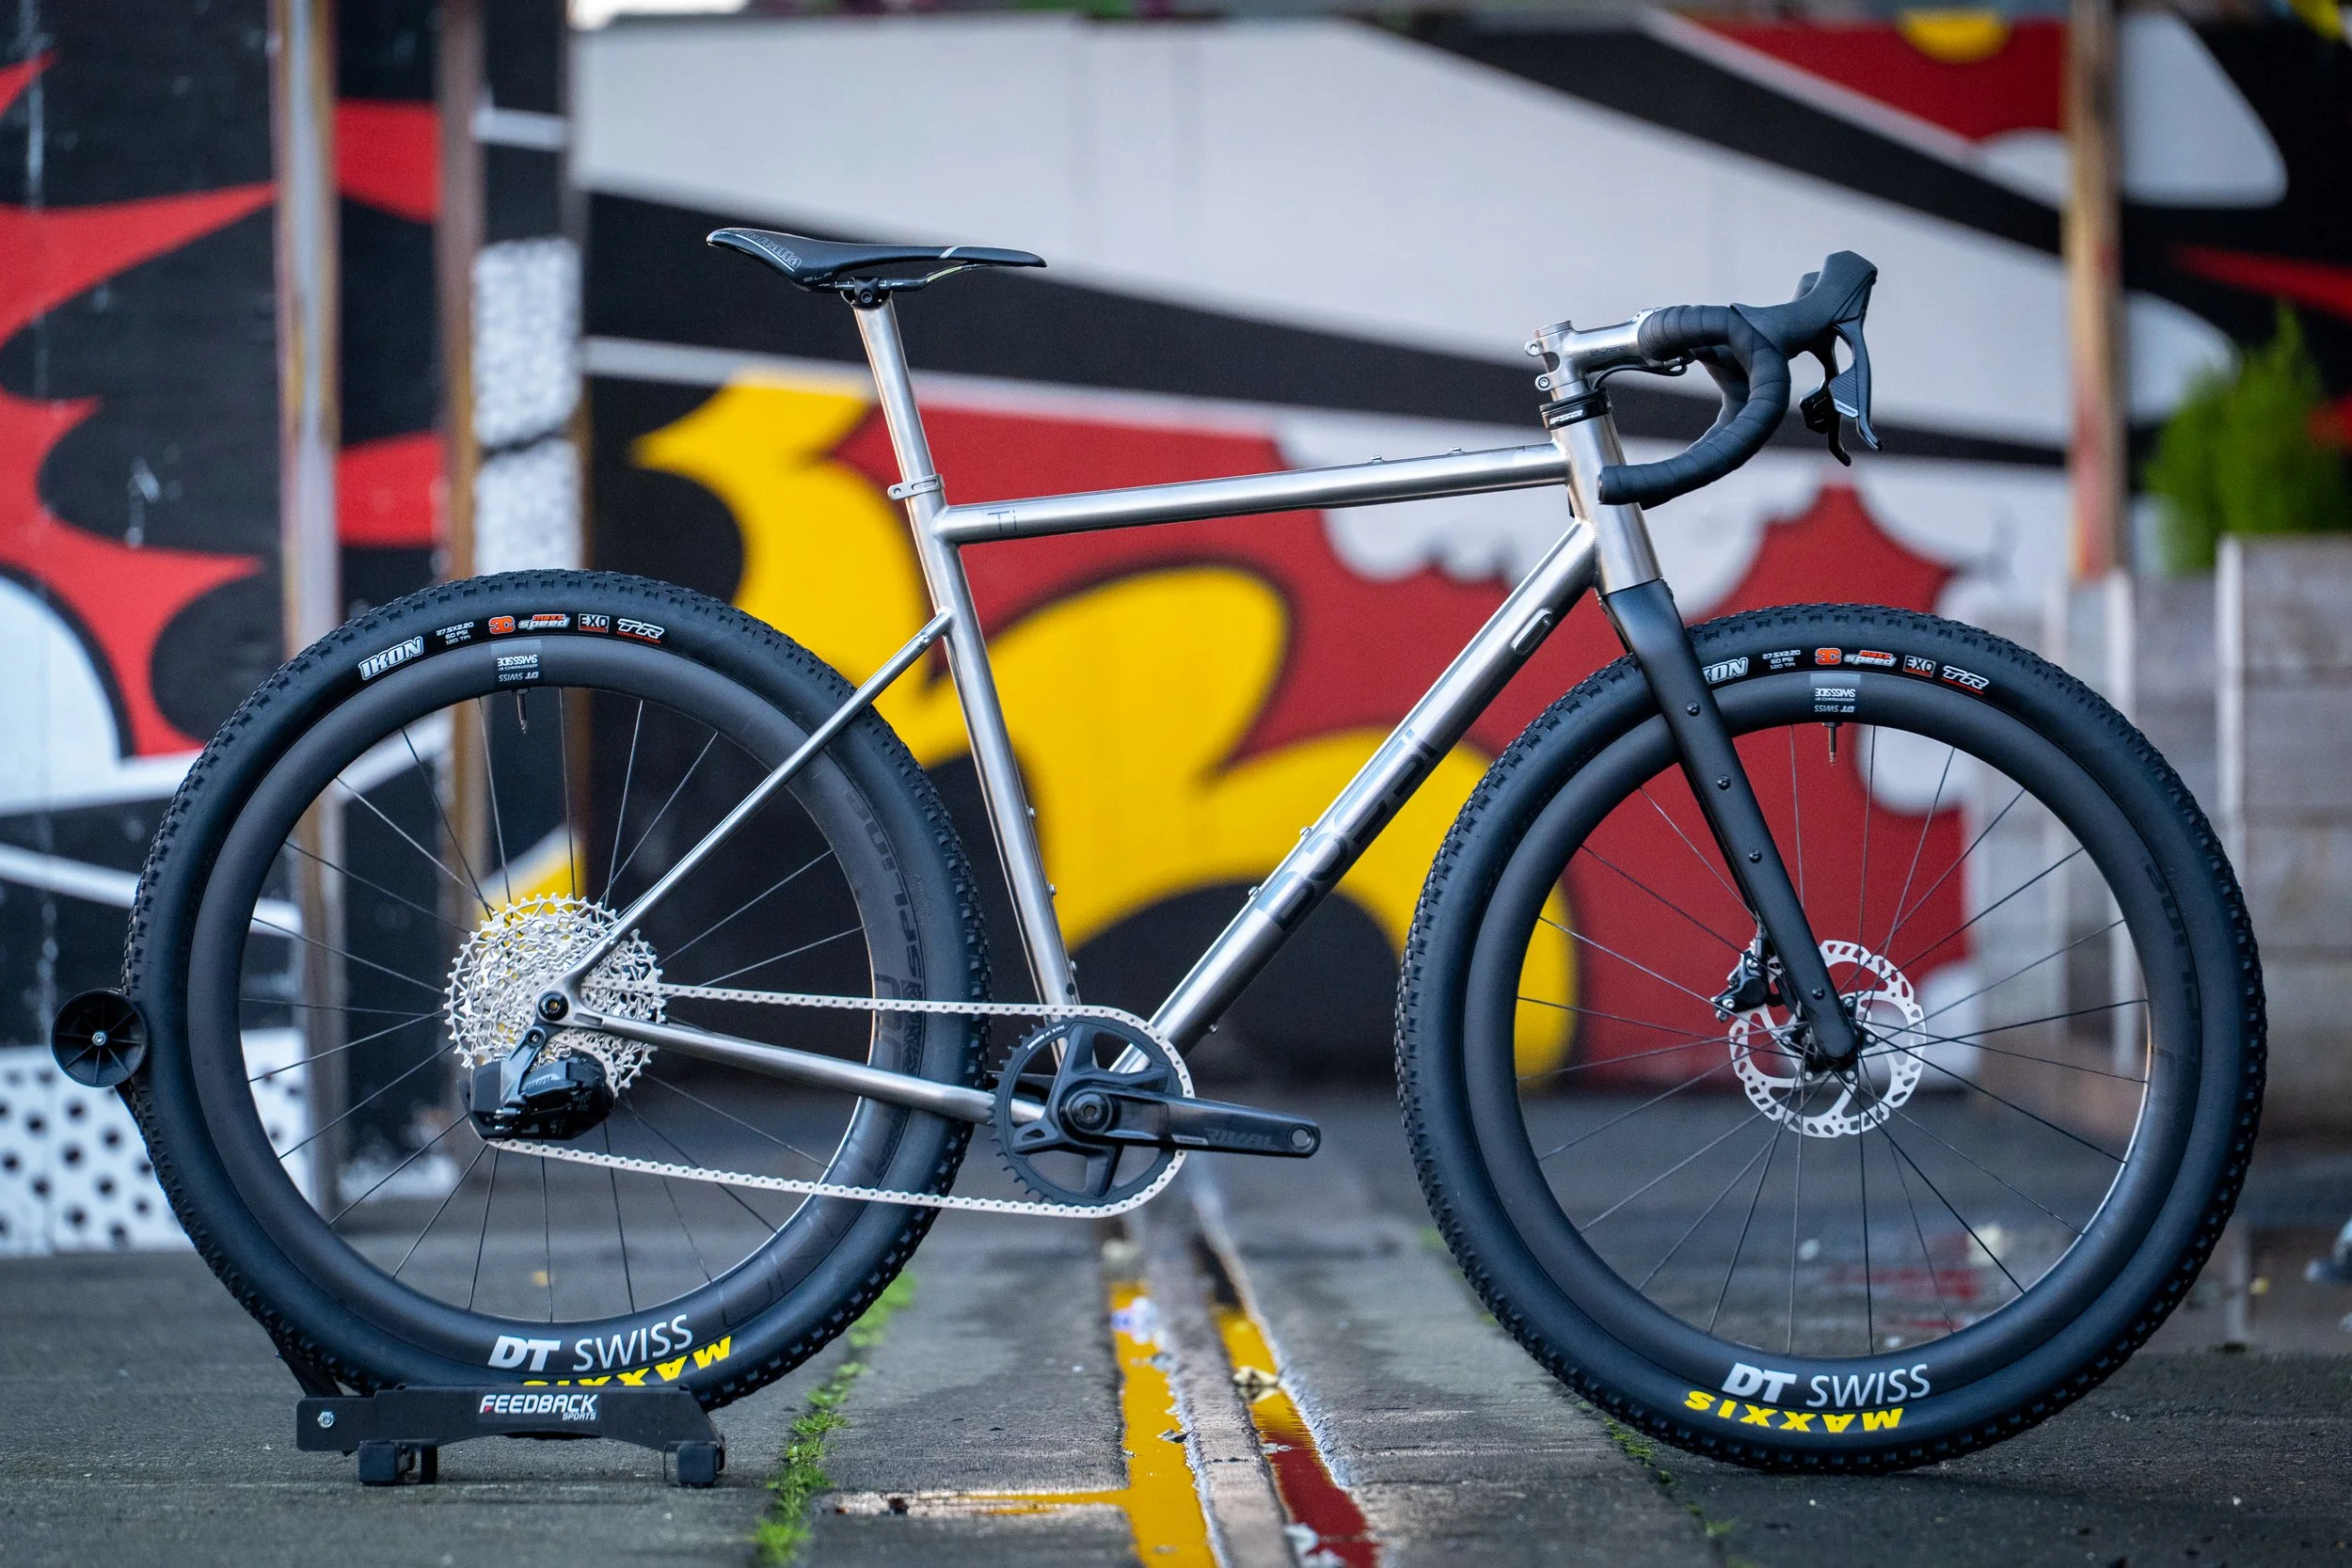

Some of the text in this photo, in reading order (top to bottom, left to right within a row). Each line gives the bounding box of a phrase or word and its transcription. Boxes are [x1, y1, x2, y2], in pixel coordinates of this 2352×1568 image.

[987, 509, 1018, 533] Ti
[518, 617, 570, 630] speed
[579, 614, 610, 628] EXO
[617, 618, 664, 640] TR
[358, 636, 423, 680] IKON
[1843, 653, 1897, 668] speed
[1905, 657, 1935, 673] EXO
[498, 671, 539, 682] DT SWISS
[1942, 665, 1990, 689] TR
[1839, 705, 1855, 713] DT
[1256, 728, 1437, 932] BOSSI
[487, 1313, 693, 1371] DT SWISS
[1721, 1362, 1931, 1408] DT SWISS
[479, 1394, 598, 1414] FEEDBACK
[1683, 1390, 1904, 1433] MAXXIS
[562, 1411, 596, 1421] SPORTS
